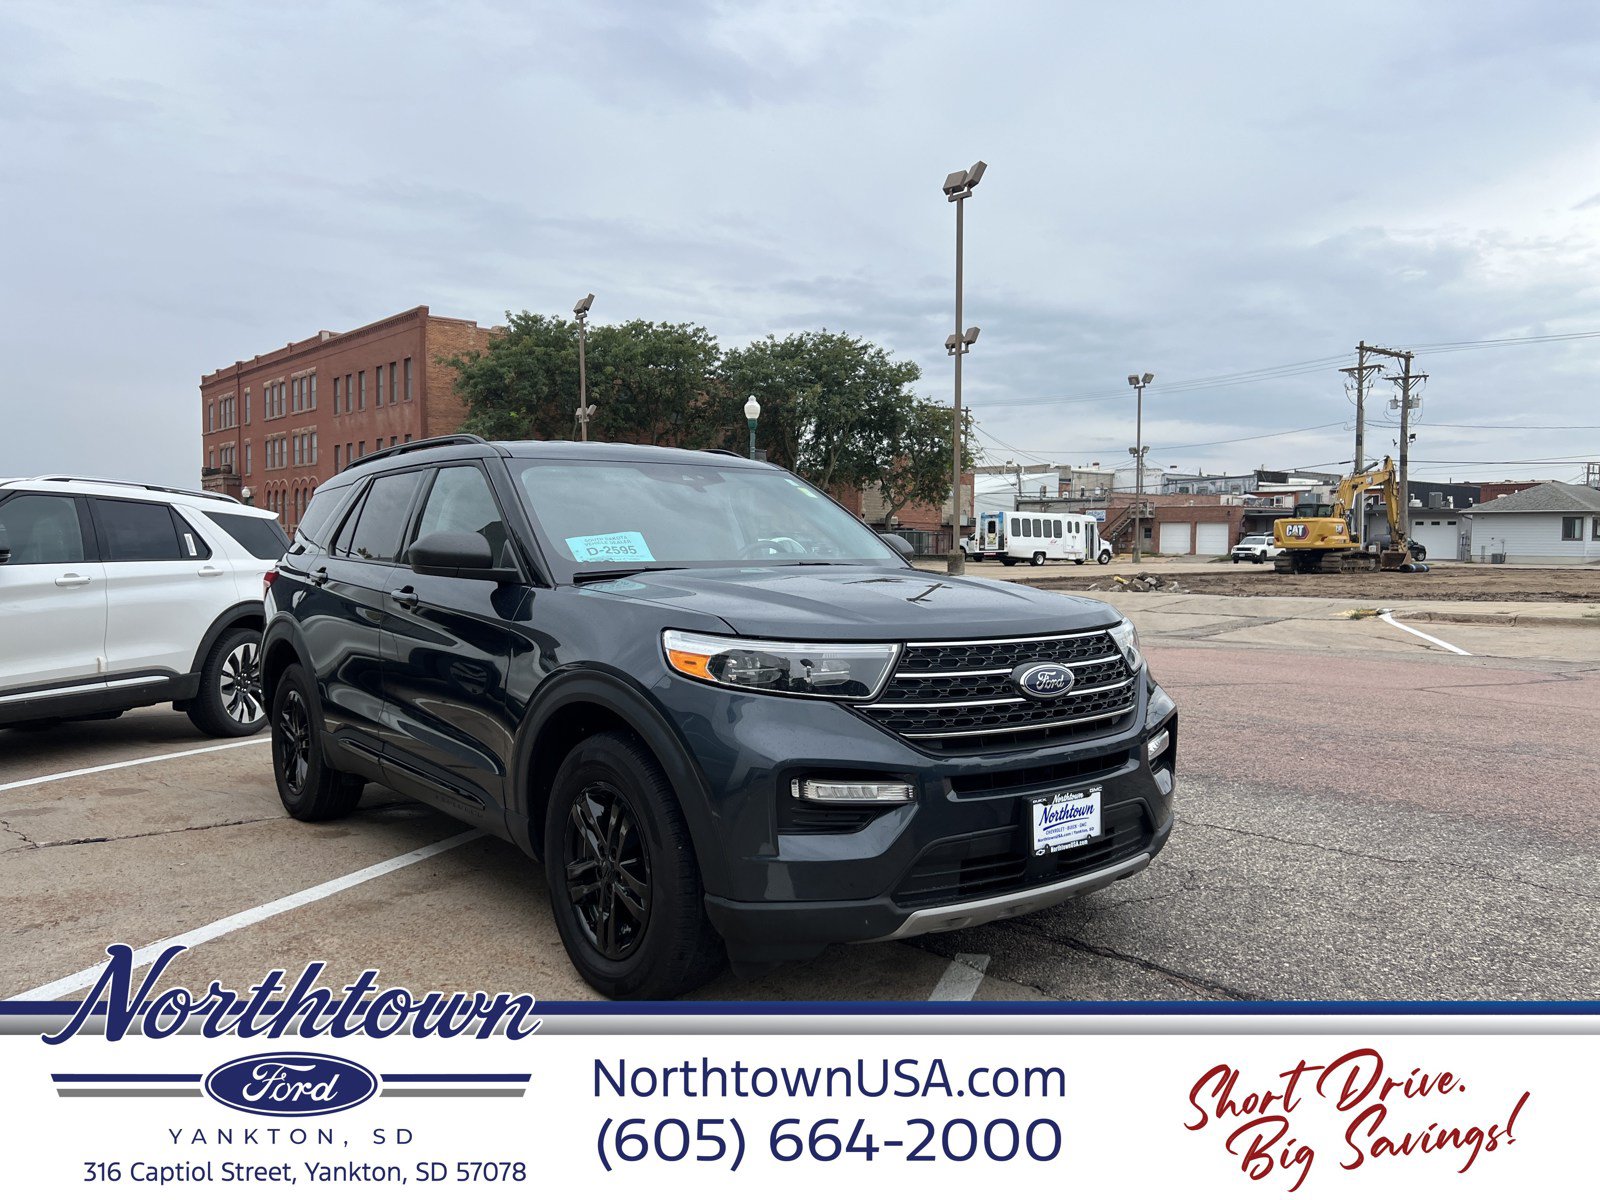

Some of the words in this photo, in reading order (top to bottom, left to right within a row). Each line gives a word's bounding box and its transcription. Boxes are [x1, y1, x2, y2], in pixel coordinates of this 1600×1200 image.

[1286, 525, 1304, 537] CAT
[586, 545, 637, 556] D-2595
[1036, 671, 1065, 691] Ford
[1052, 792, 1084, 804] Northtown
[1038, 803, 1095, 826] Northtown
[1045, 827, 1065, 835] CHEVROLET
[1050, 839, 1088, 853] NorthtownUSA.com
